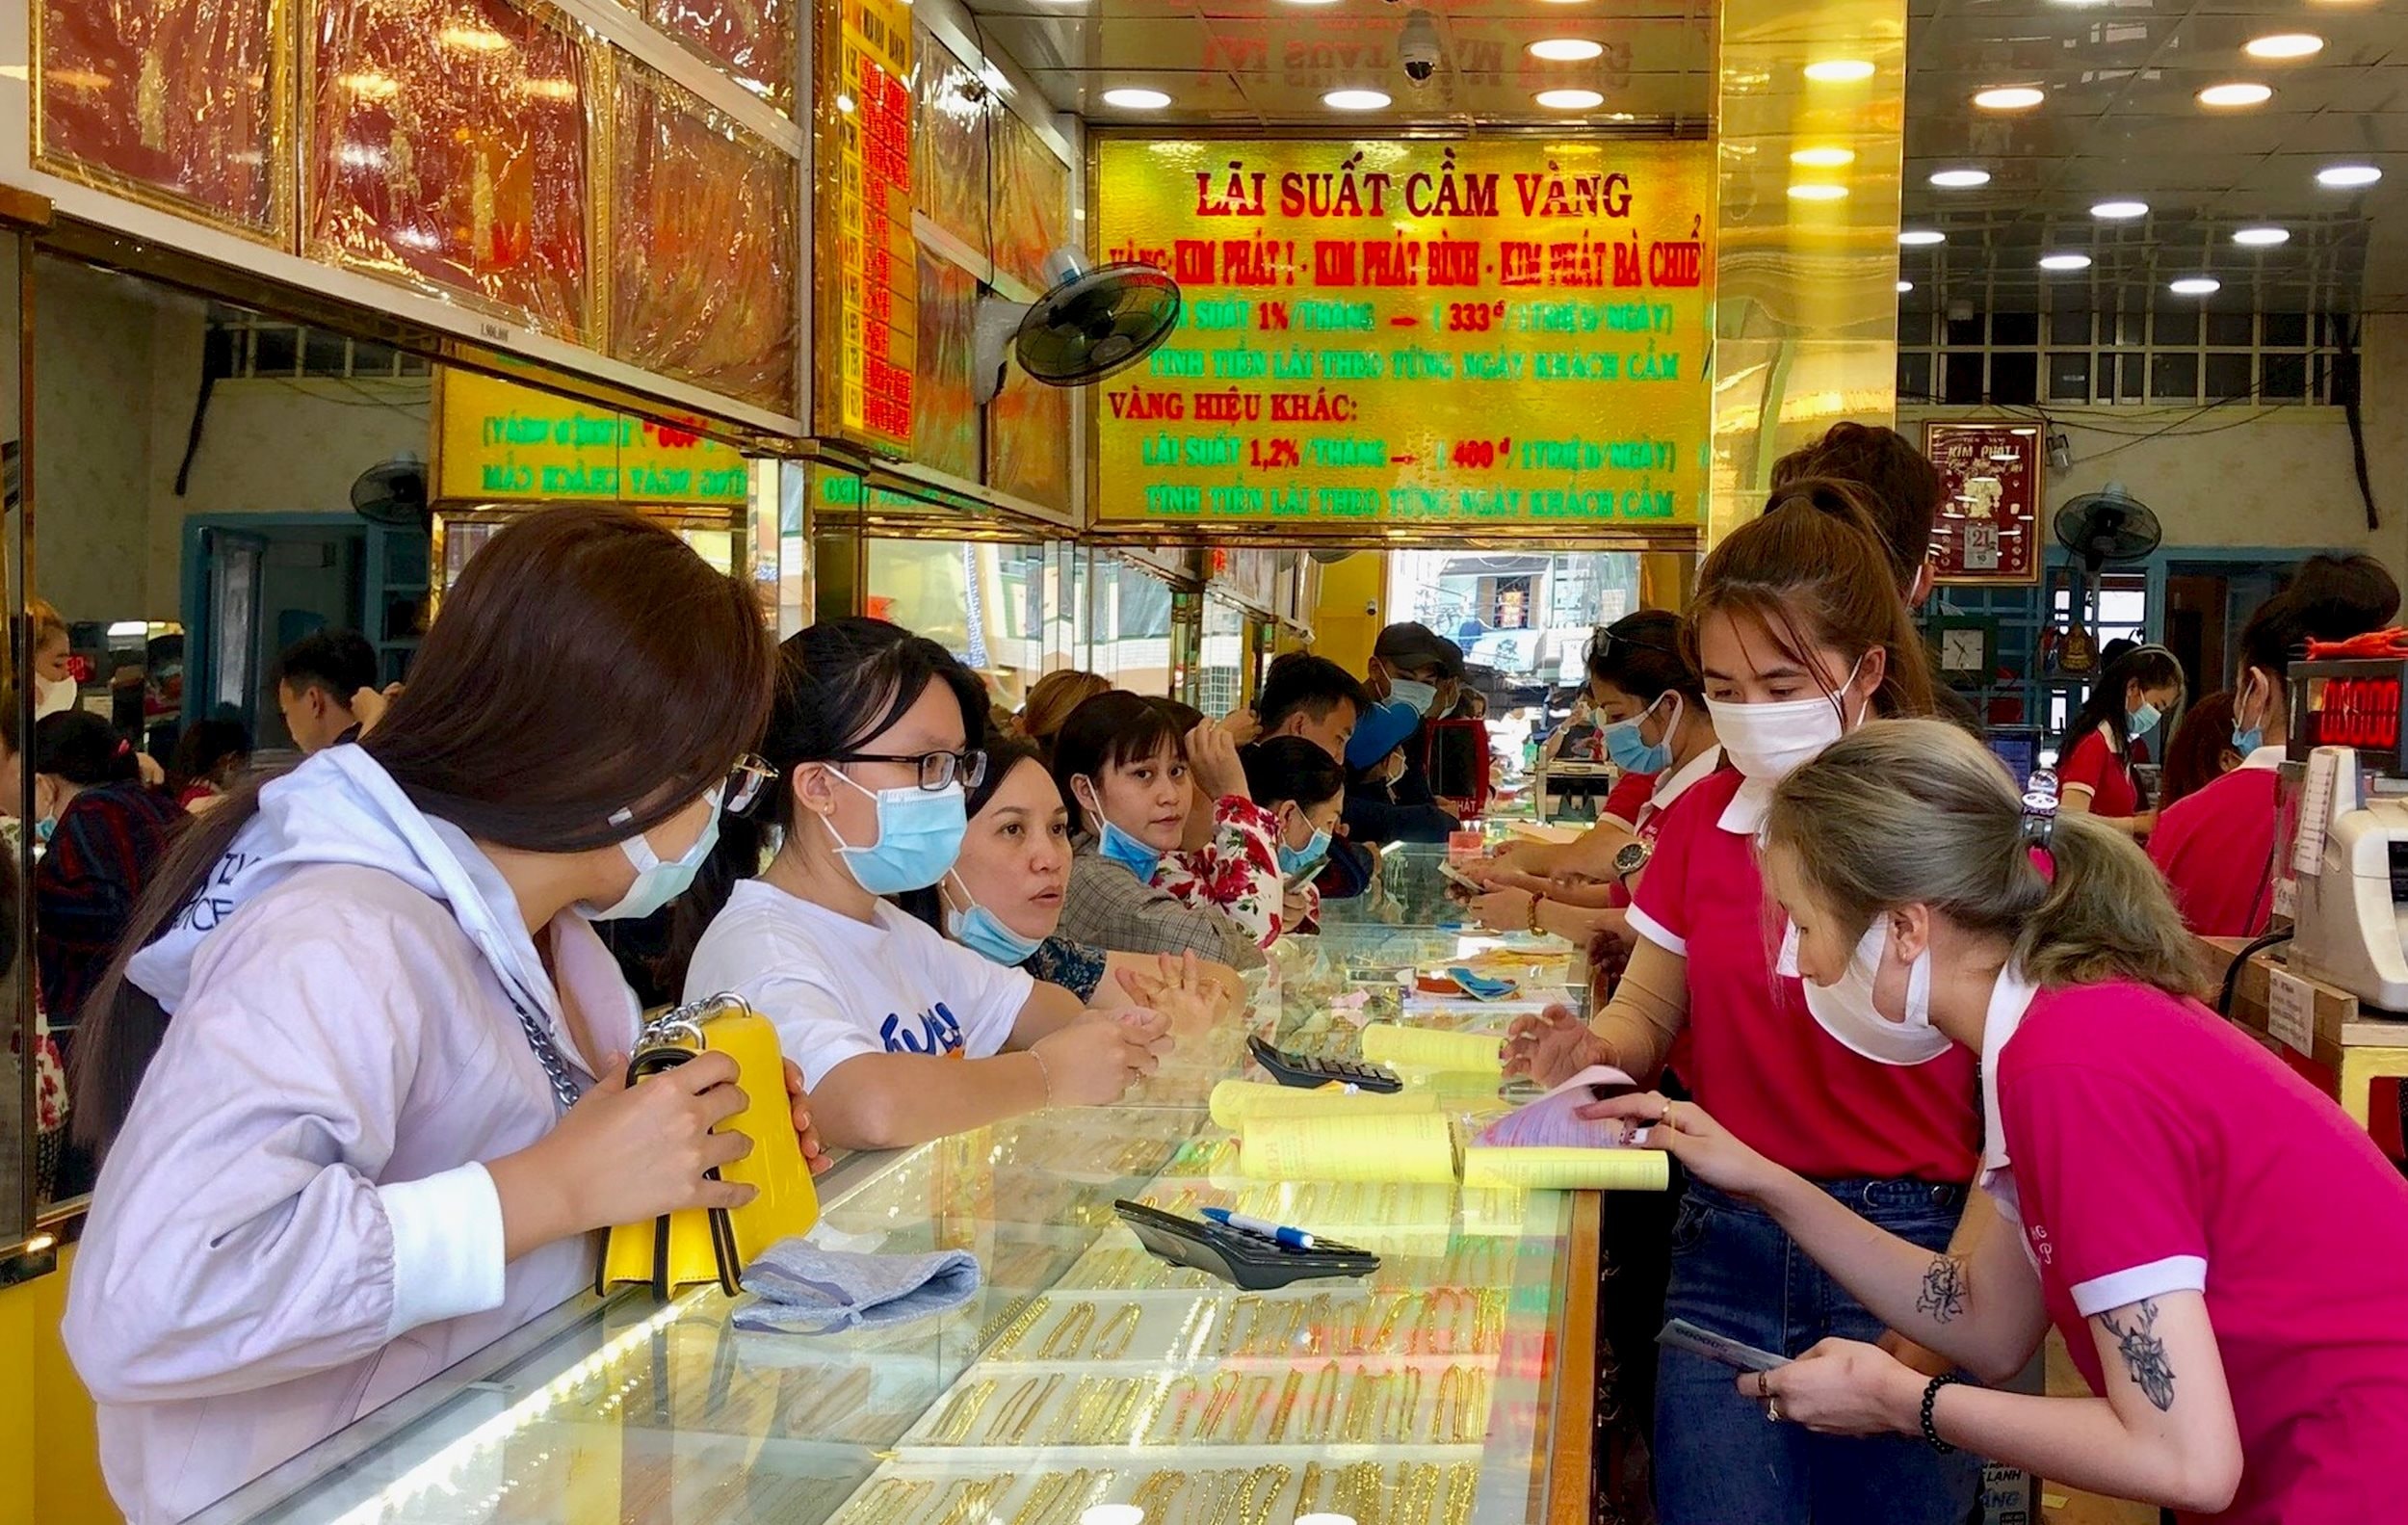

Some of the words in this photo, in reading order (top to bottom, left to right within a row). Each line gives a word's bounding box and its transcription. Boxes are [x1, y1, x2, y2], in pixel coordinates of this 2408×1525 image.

[1196, 160, 1267, 217] LÃI
[1280, 150, 1391, 217] SUẤT
[1405, 146, 1500, 217] CẦM
[1513, 160, 1633, 218] VÀNG
[1175, 239, 1216, 285] KIM
[1223, 227, 1280, 286] PHÁT
[1315, 241, 1356, 286] KIM
[1363, 229, 1421, 286] PHÁT
[1426, 228, 1479, 286] BÌNH
[1501, 241, 1542, 286] KIM
[1549, 228, 1607, 286] PHÁT
[1612, 228, 1642, 286] BÀ
[1273, 343, 1313, 379] LÃI
[1321, 349, 1384, 379] THEO
[1461, 344, 1526, 380] NGÀY
[1533, 346, 1620, 380] KHÁCH
[1108, 385, 1184, 420] VÀNG
[1193, 385, 1261, 426] HIỆU
[1270, 386, 1358, 421] KHÁC:
[1142, 431, 1180, 466] LÃI
[1270, 481, 1310, 515] LÃI
[1317, 486, 1380, 515] THEO
[1530, 481, 1614, 517] KHÁCH
[1457, 798, 1476, 813] HÁT
